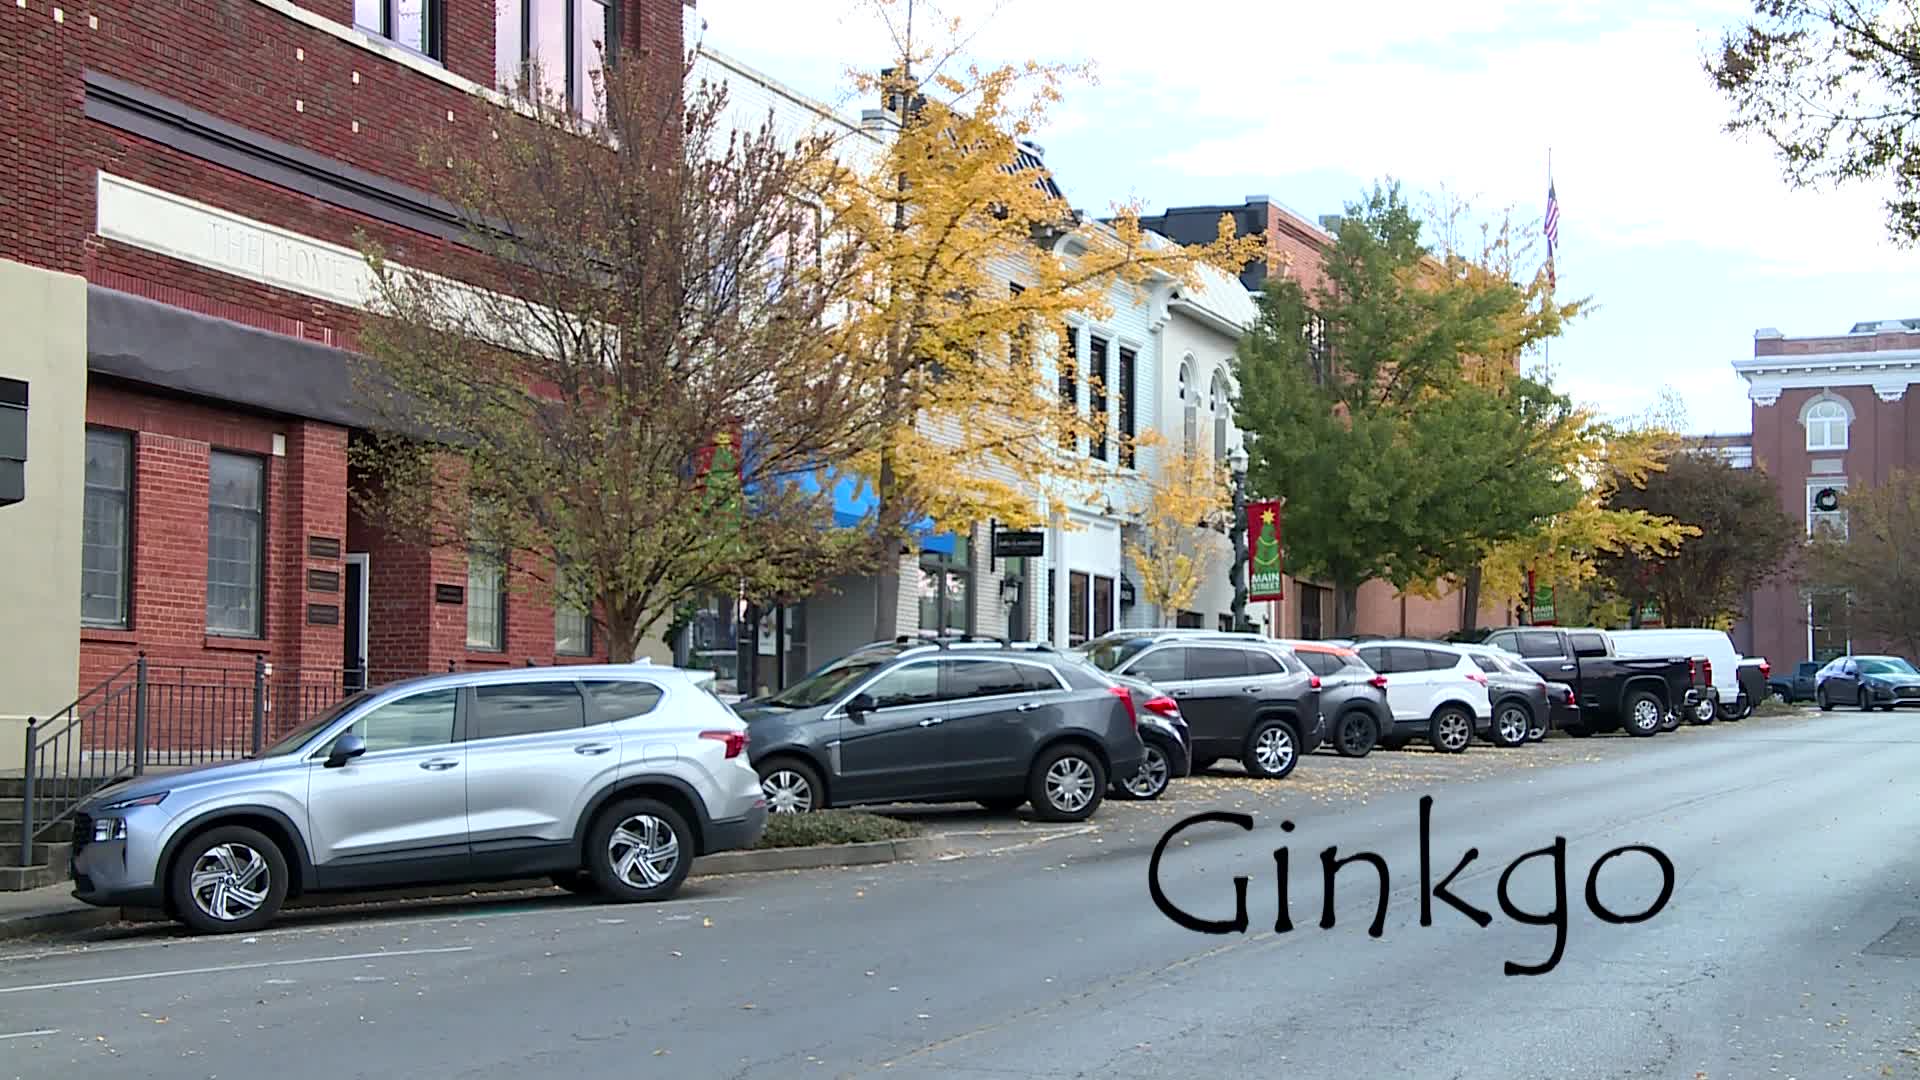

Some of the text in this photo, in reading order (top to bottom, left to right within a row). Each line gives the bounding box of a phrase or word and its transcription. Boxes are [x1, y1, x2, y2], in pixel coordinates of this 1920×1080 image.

[208, 222, 345, 289] THE HOME
[1251, 572, 1280, 582] MAIN
[1251, 582, 1280, 591] STREET
